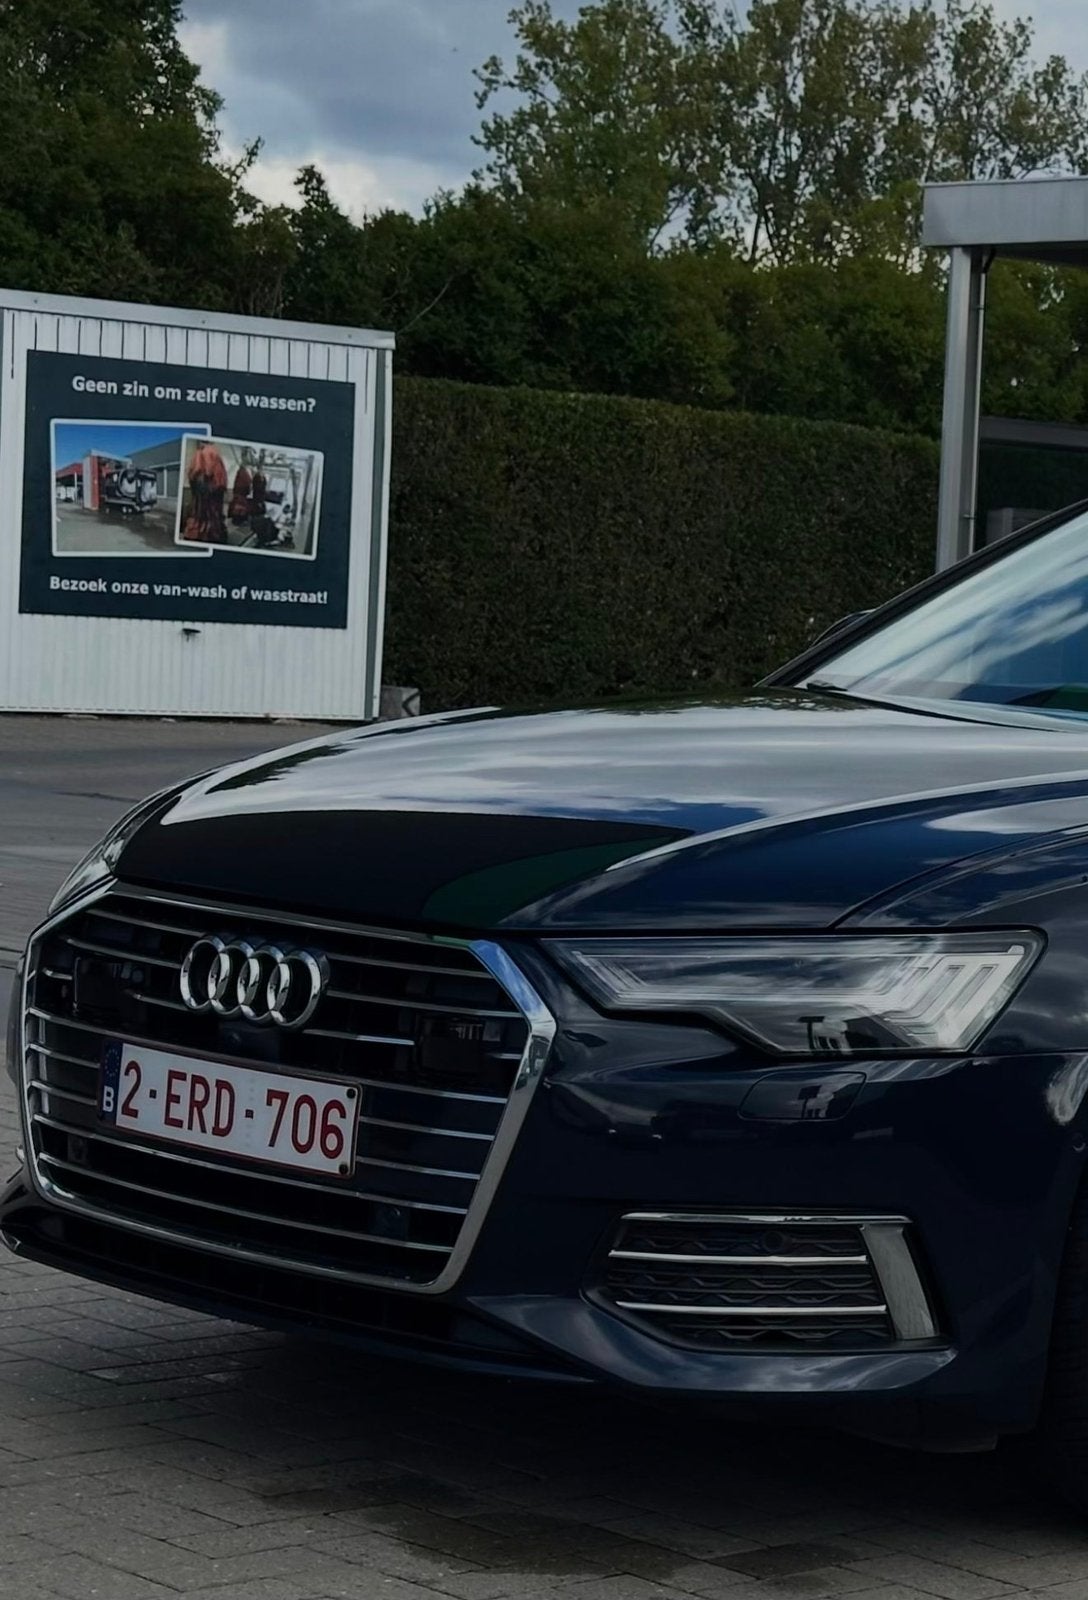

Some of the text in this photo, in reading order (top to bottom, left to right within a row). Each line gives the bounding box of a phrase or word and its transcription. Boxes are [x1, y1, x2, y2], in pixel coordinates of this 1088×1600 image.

[72, 375, 316, 412] Geen zin om zelf te wassen?
[49, 576, 328, 604] Bezoek onze van-wash of wasstraat!
[102, 1085, 115, 1112] B
